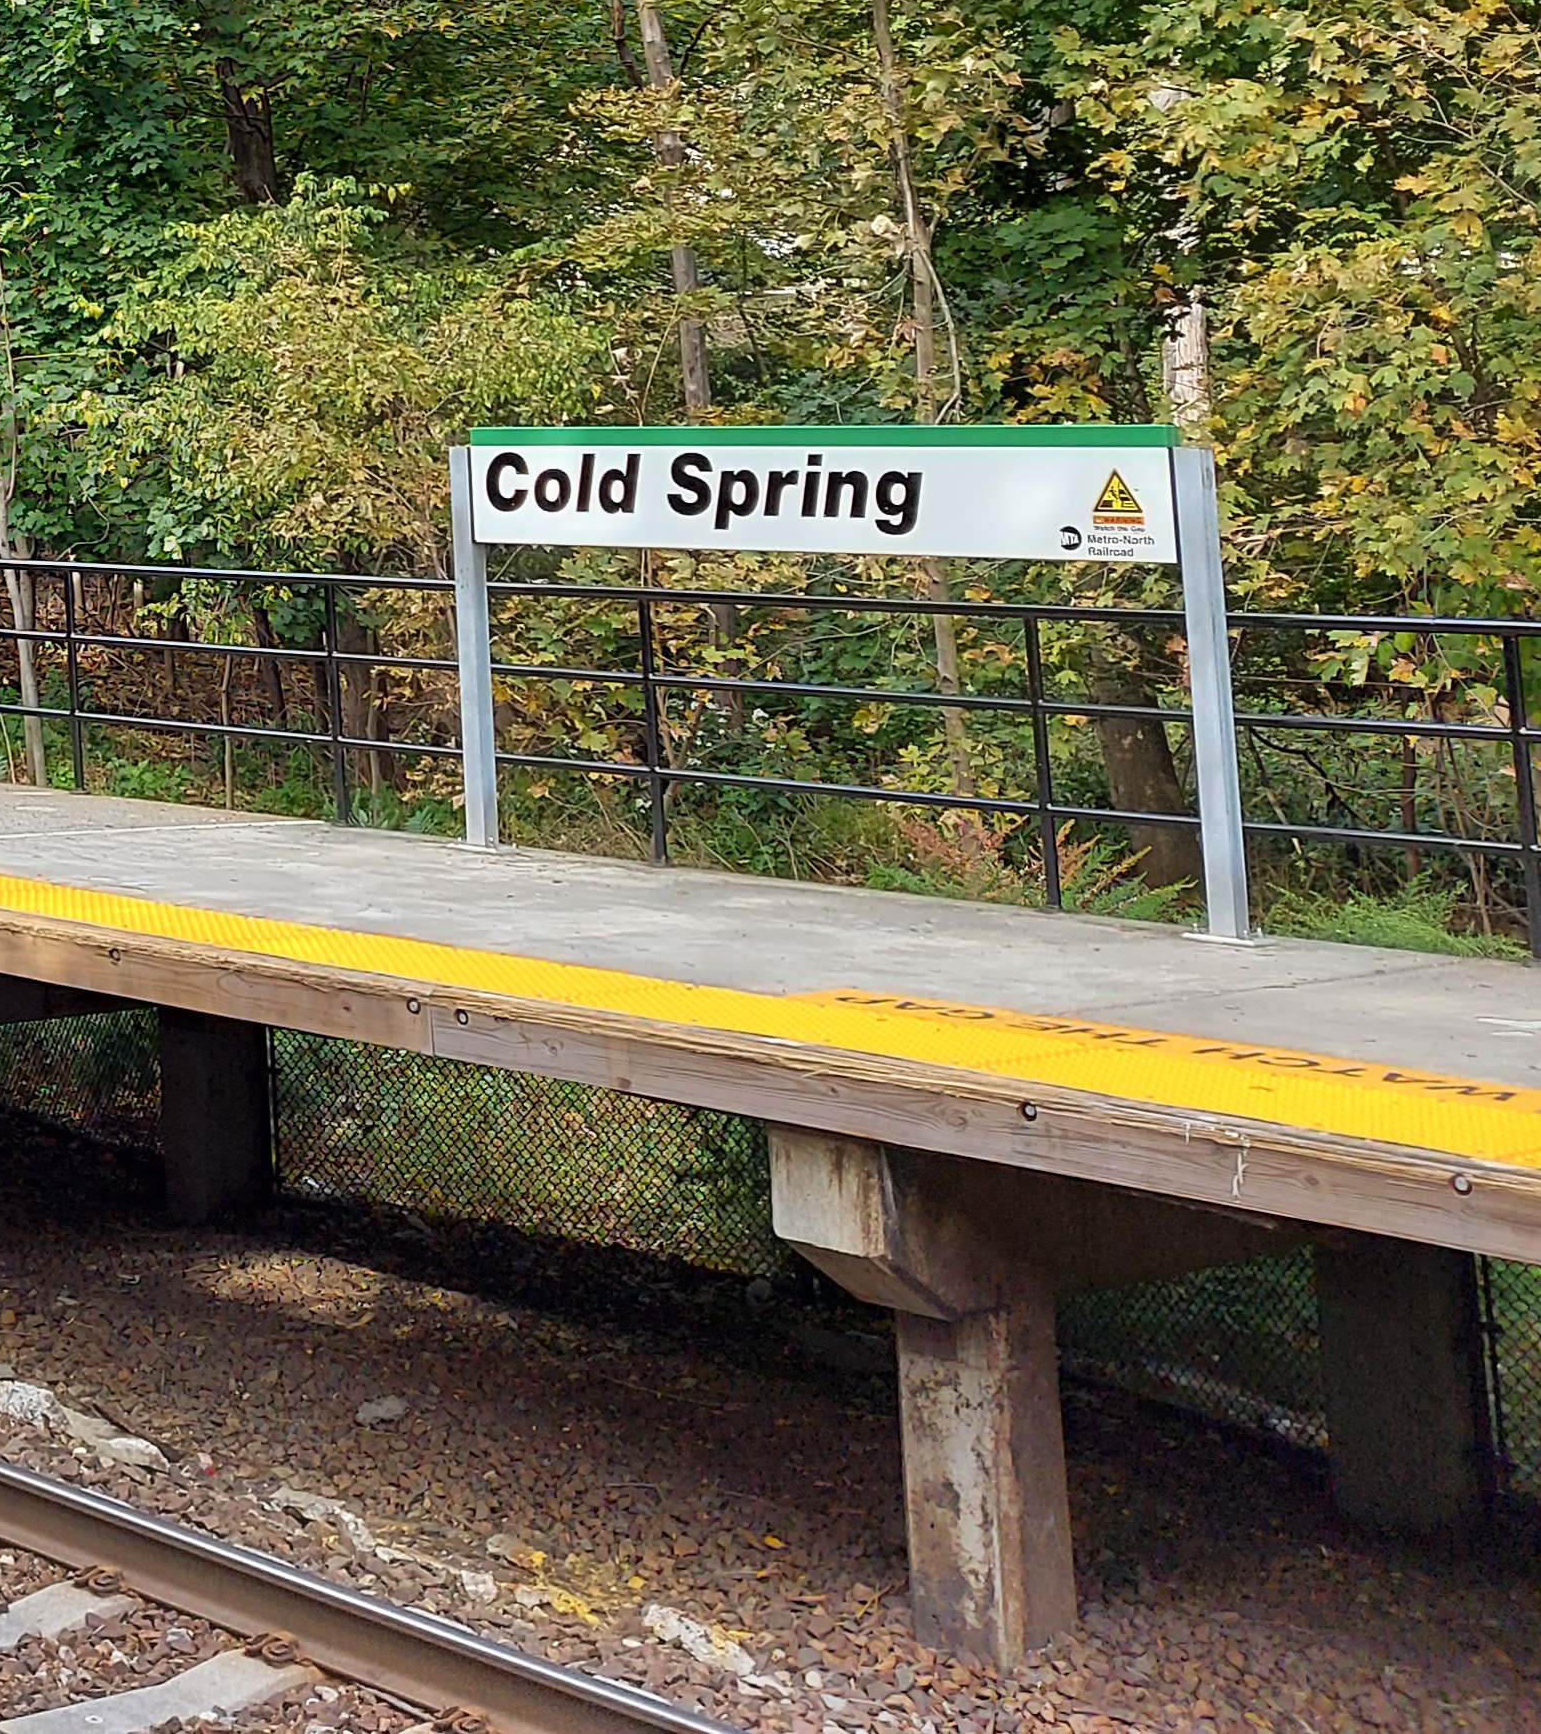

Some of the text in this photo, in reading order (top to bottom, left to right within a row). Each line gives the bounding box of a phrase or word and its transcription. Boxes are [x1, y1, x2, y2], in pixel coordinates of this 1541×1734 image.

[485, 451, 923, 536] Cold Spring
[1087, 534, 1155, 545] Metro-North
[1088, 546, 1134, 557] Railroad
[835, 996, 1517, 1102] WATCH THE GAP
